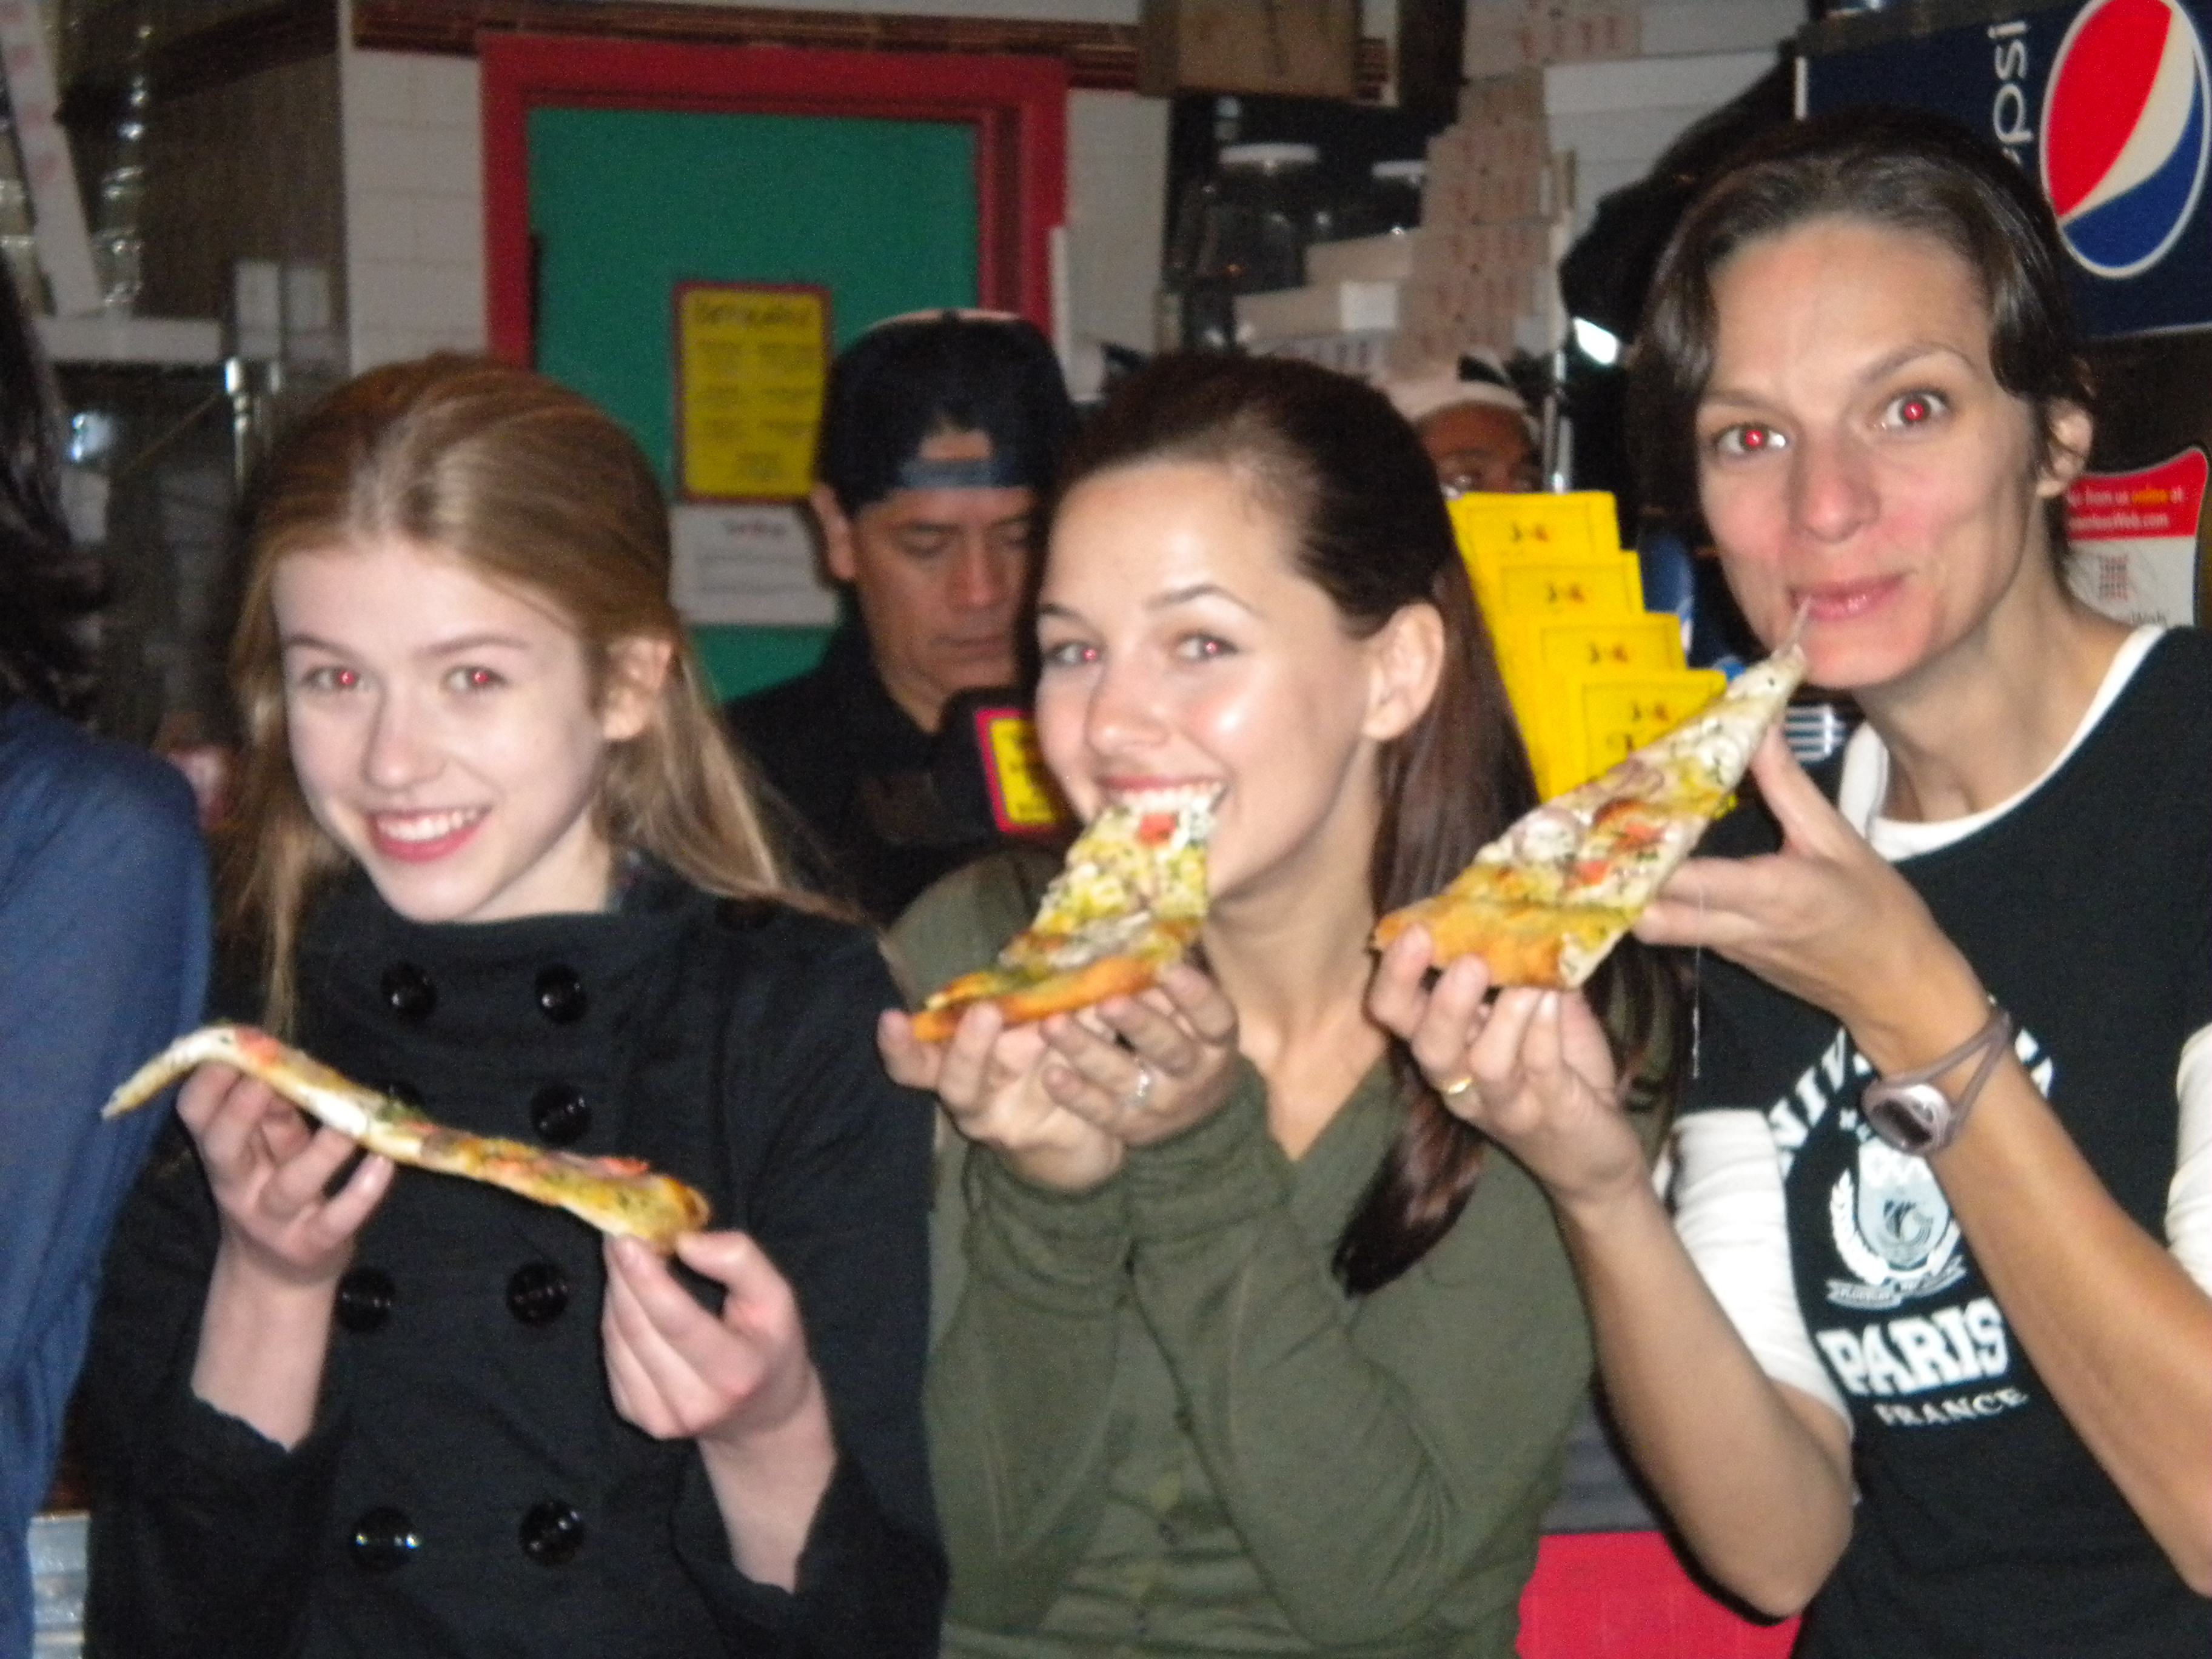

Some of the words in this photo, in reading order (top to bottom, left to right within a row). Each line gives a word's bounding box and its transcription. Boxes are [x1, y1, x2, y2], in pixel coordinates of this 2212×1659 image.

[1988, 22, 2033, 166] psi
[1817, 1298, 2008, 1395] PARIS
[1875, 1389, 2027, 1426] FRANCE
